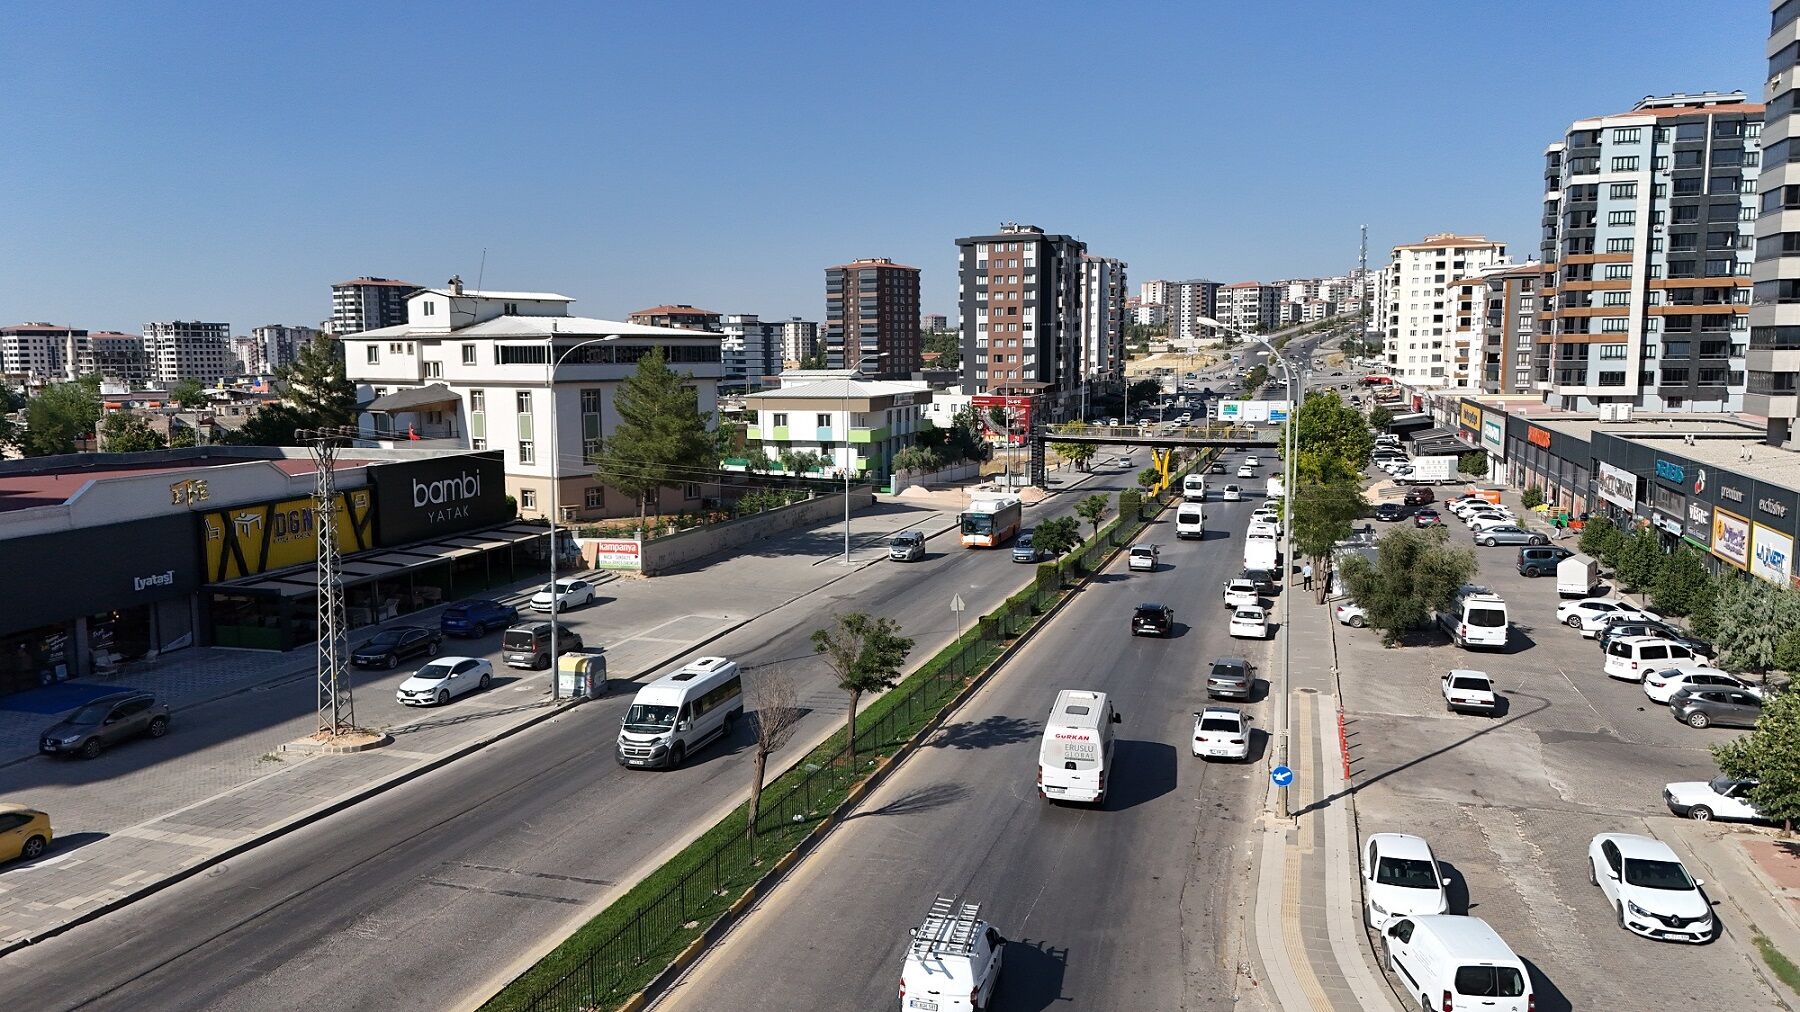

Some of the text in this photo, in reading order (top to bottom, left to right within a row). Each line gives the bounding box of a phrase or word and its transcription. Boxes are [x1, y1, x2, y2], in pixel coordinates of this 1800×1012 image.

[412, 468, 480, 508] bambi
[428, 505, 469, 524] YATAK
[599, 543, 636, 552] kampanya
[1065, 743, 1094, 752] ERUSLU
